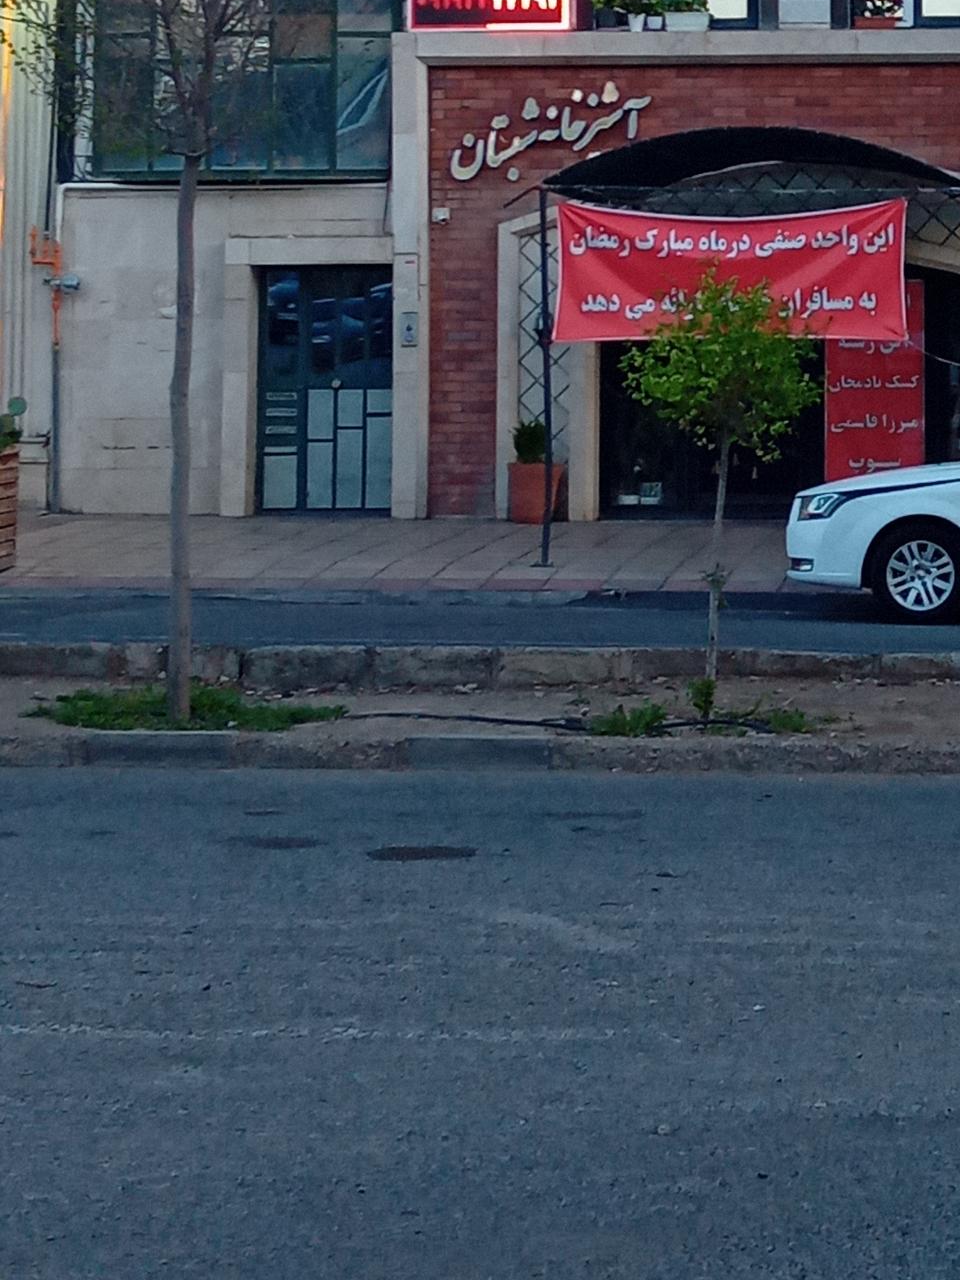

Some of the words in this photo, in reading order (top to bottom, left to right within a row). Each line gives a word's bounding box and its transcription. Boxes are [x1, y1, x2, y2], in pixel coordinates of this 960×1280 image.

[569, 225, 631, 257] رمضان
[635, 228, 694, 258] مبارک
[755, 229, 807, 257] صنفی
[811, 224, 860, 255] واحد
[863, 222, 895, 254] این
[581, 294, 621, 313] دهد
[778, 285, 854, 320] مسافران
[859, 291, 877, 316] به
